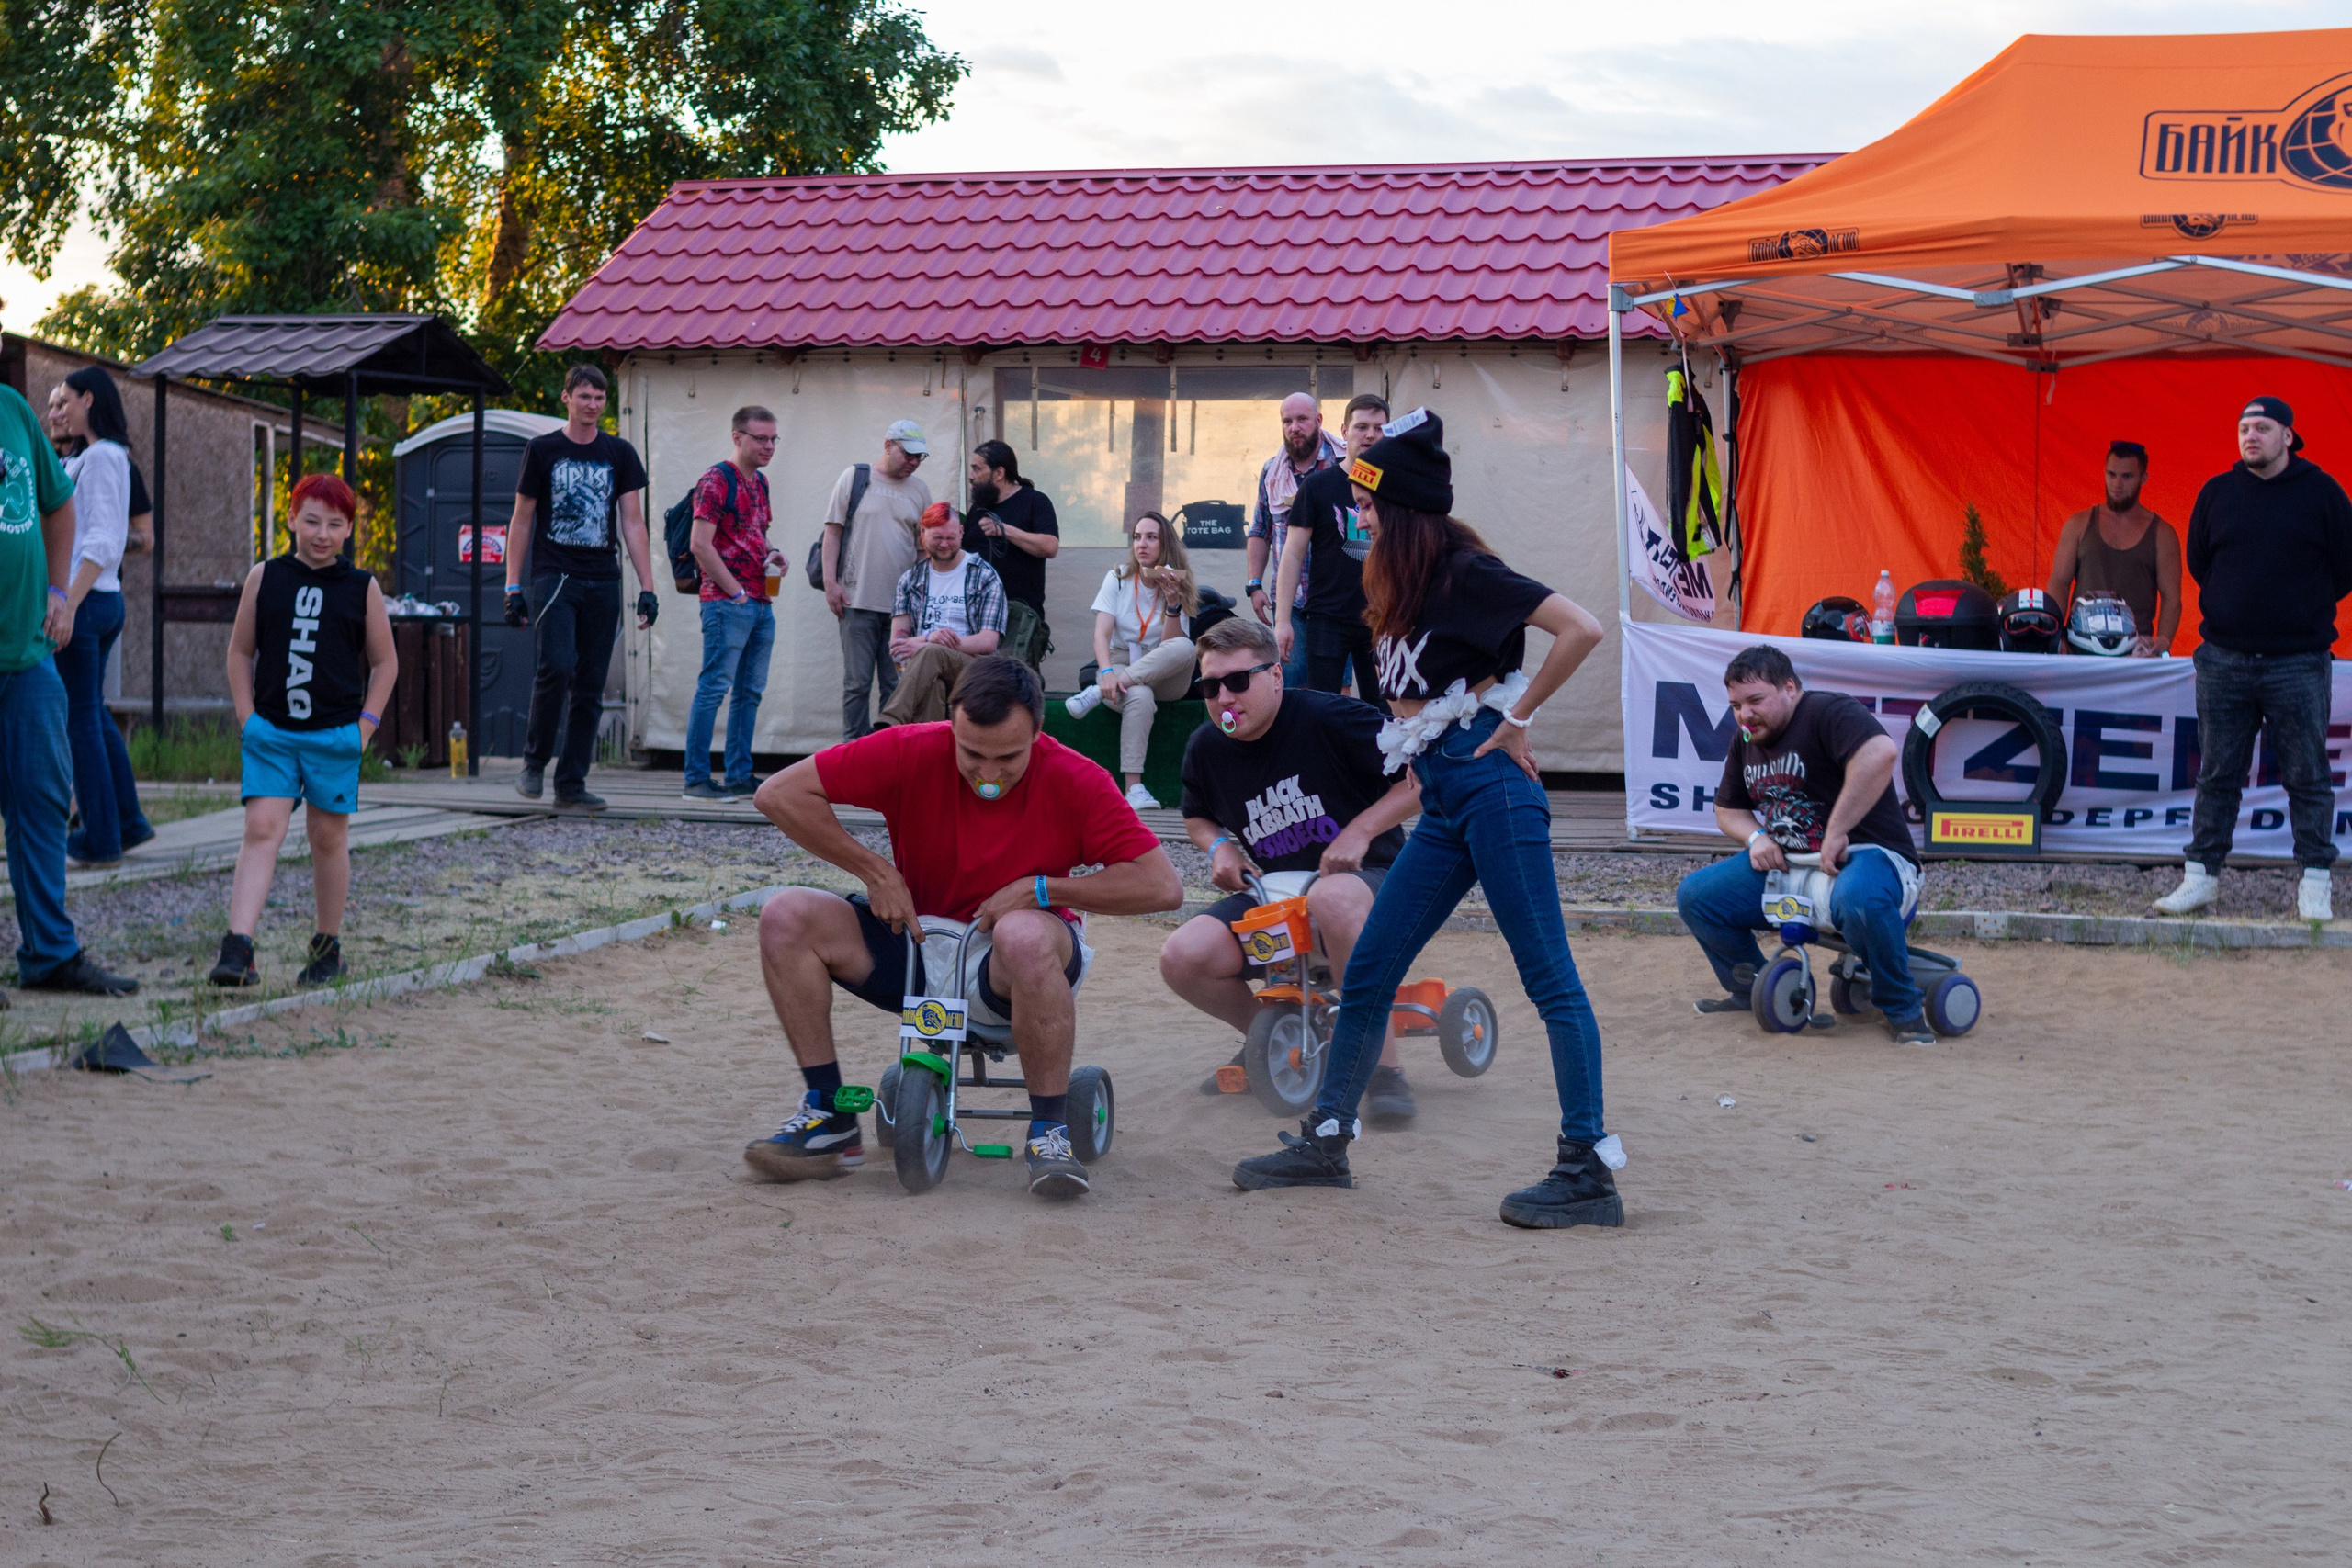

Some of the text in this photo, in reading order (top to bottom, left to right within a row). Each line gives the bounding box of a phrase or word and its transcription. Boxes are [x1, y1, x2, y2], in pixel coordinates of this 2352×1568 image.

[2155, 117, 2278, 174] БАЙК
[1751, 239, 1780, 262] БАЙК
[1090, 347, 1102, 363] 4
[1245, 774, 1304, 821] BLACK
[1242, 794, 1326, 846] SABBATH
[1941, 818, 2024, 839] PIRELLI
